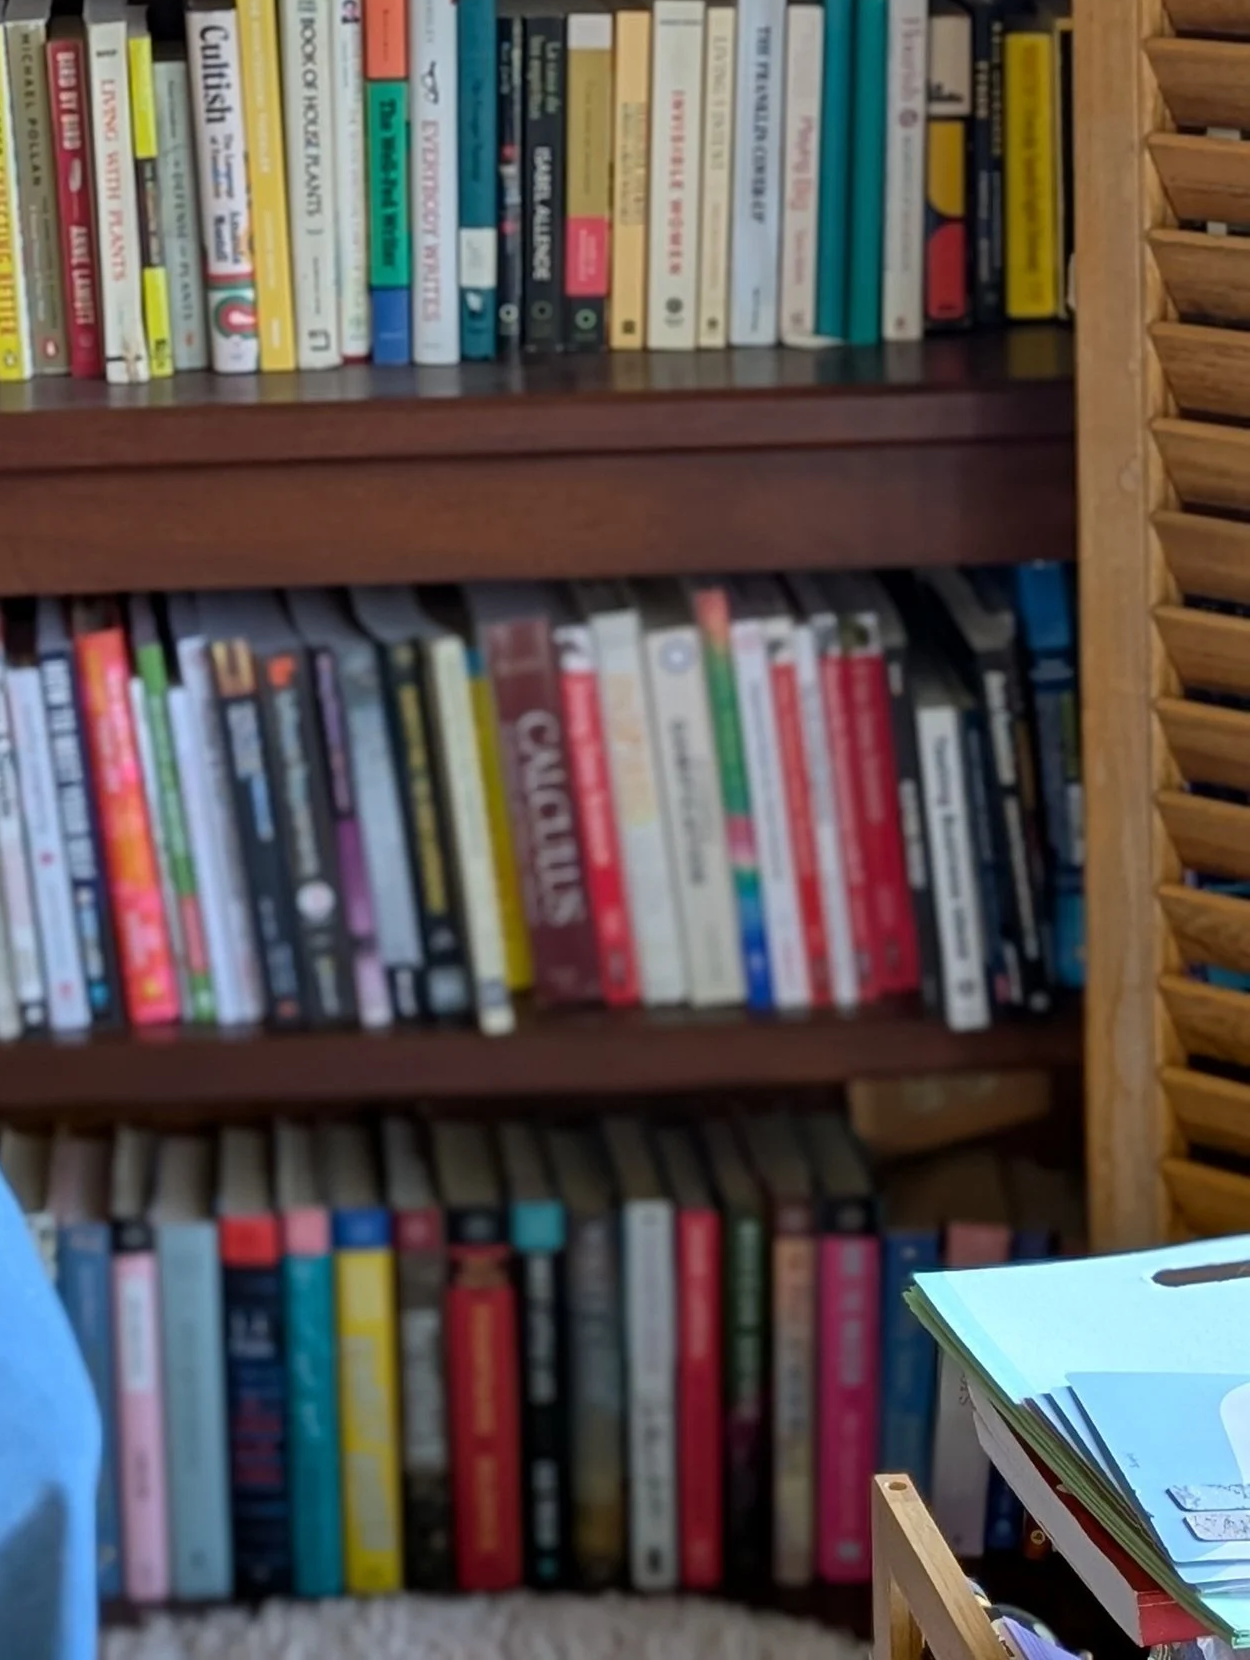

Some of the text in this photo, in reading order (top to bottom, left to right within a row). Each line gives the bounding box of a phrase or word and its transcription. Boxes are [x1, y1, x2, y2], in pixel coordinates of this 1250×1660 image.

[19, 33, 43, 188] MICHAEL POLLAN
[199, 24, 233, 124] Cultish
[300, 17, 322, 217] BOOK OF HOUSE PLANTS
[545, 42, 559, 59] La
[546, 95, 560, 113] de
[55, 51, 96, 326] BIRD BY BIRD ANNE LAMOTT
[100, 79, 128, 282] LIVING WITH PLANTS
[378, 99, 398, 269] The Well-Fed Writer
[419, 119, 441, 323] EVERYBODY WRITES
[532, 146, 552, 282] ISABEL ALLENDE
[668, 90, 687, 276] INVISIBLE WOMEN
[516, 710, 585, 928] CALCULUS
